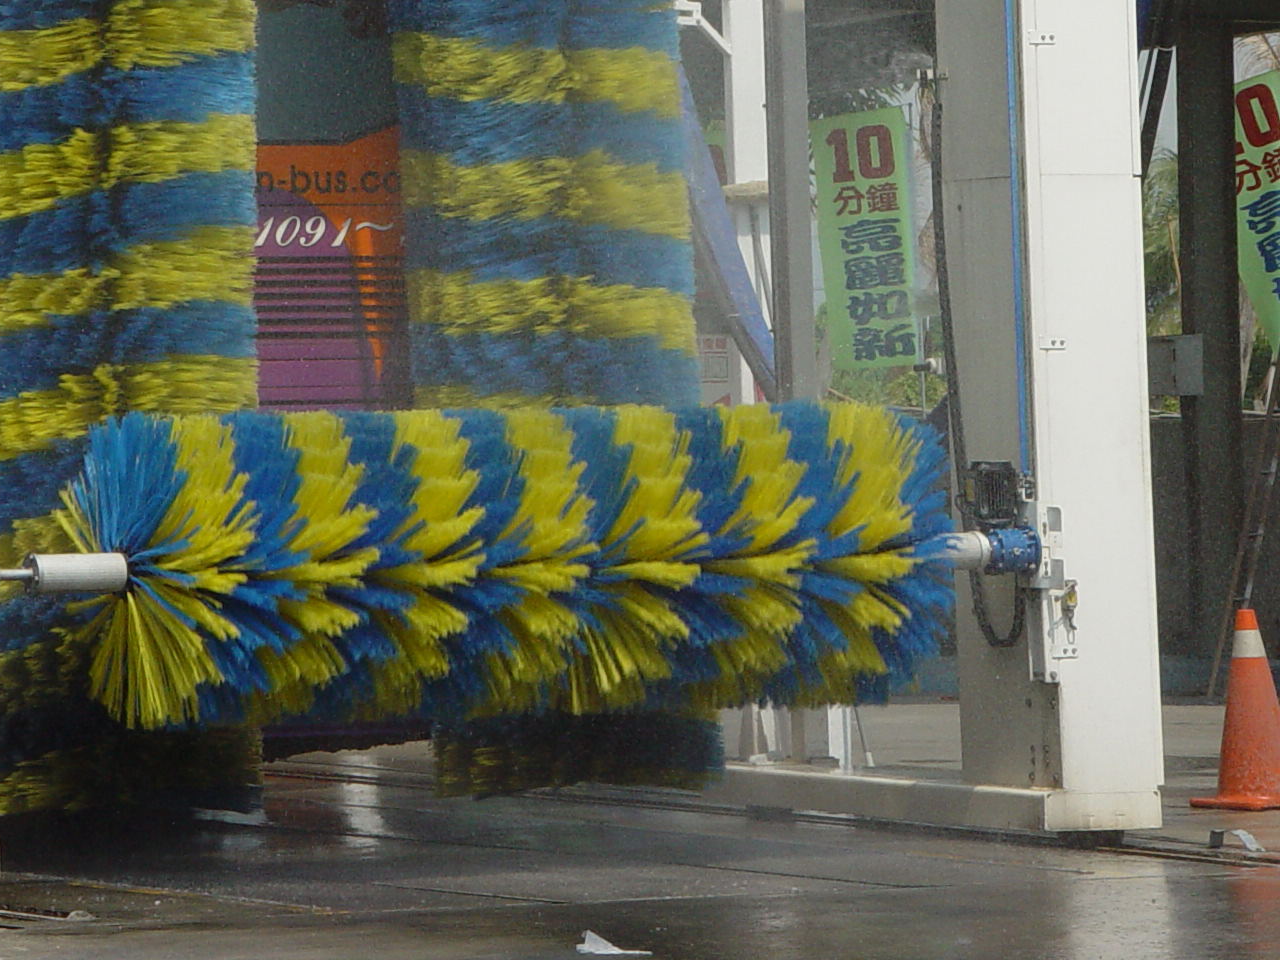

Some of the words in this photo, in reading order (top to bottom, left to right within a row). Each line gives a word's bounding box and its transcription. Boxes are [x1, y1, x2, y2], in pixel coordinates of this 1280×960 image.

[826, 124, 896, 183] 10
[833, 181, 900, 216] 分鐘
[838, 217, 917, 361] 亮麗如新
